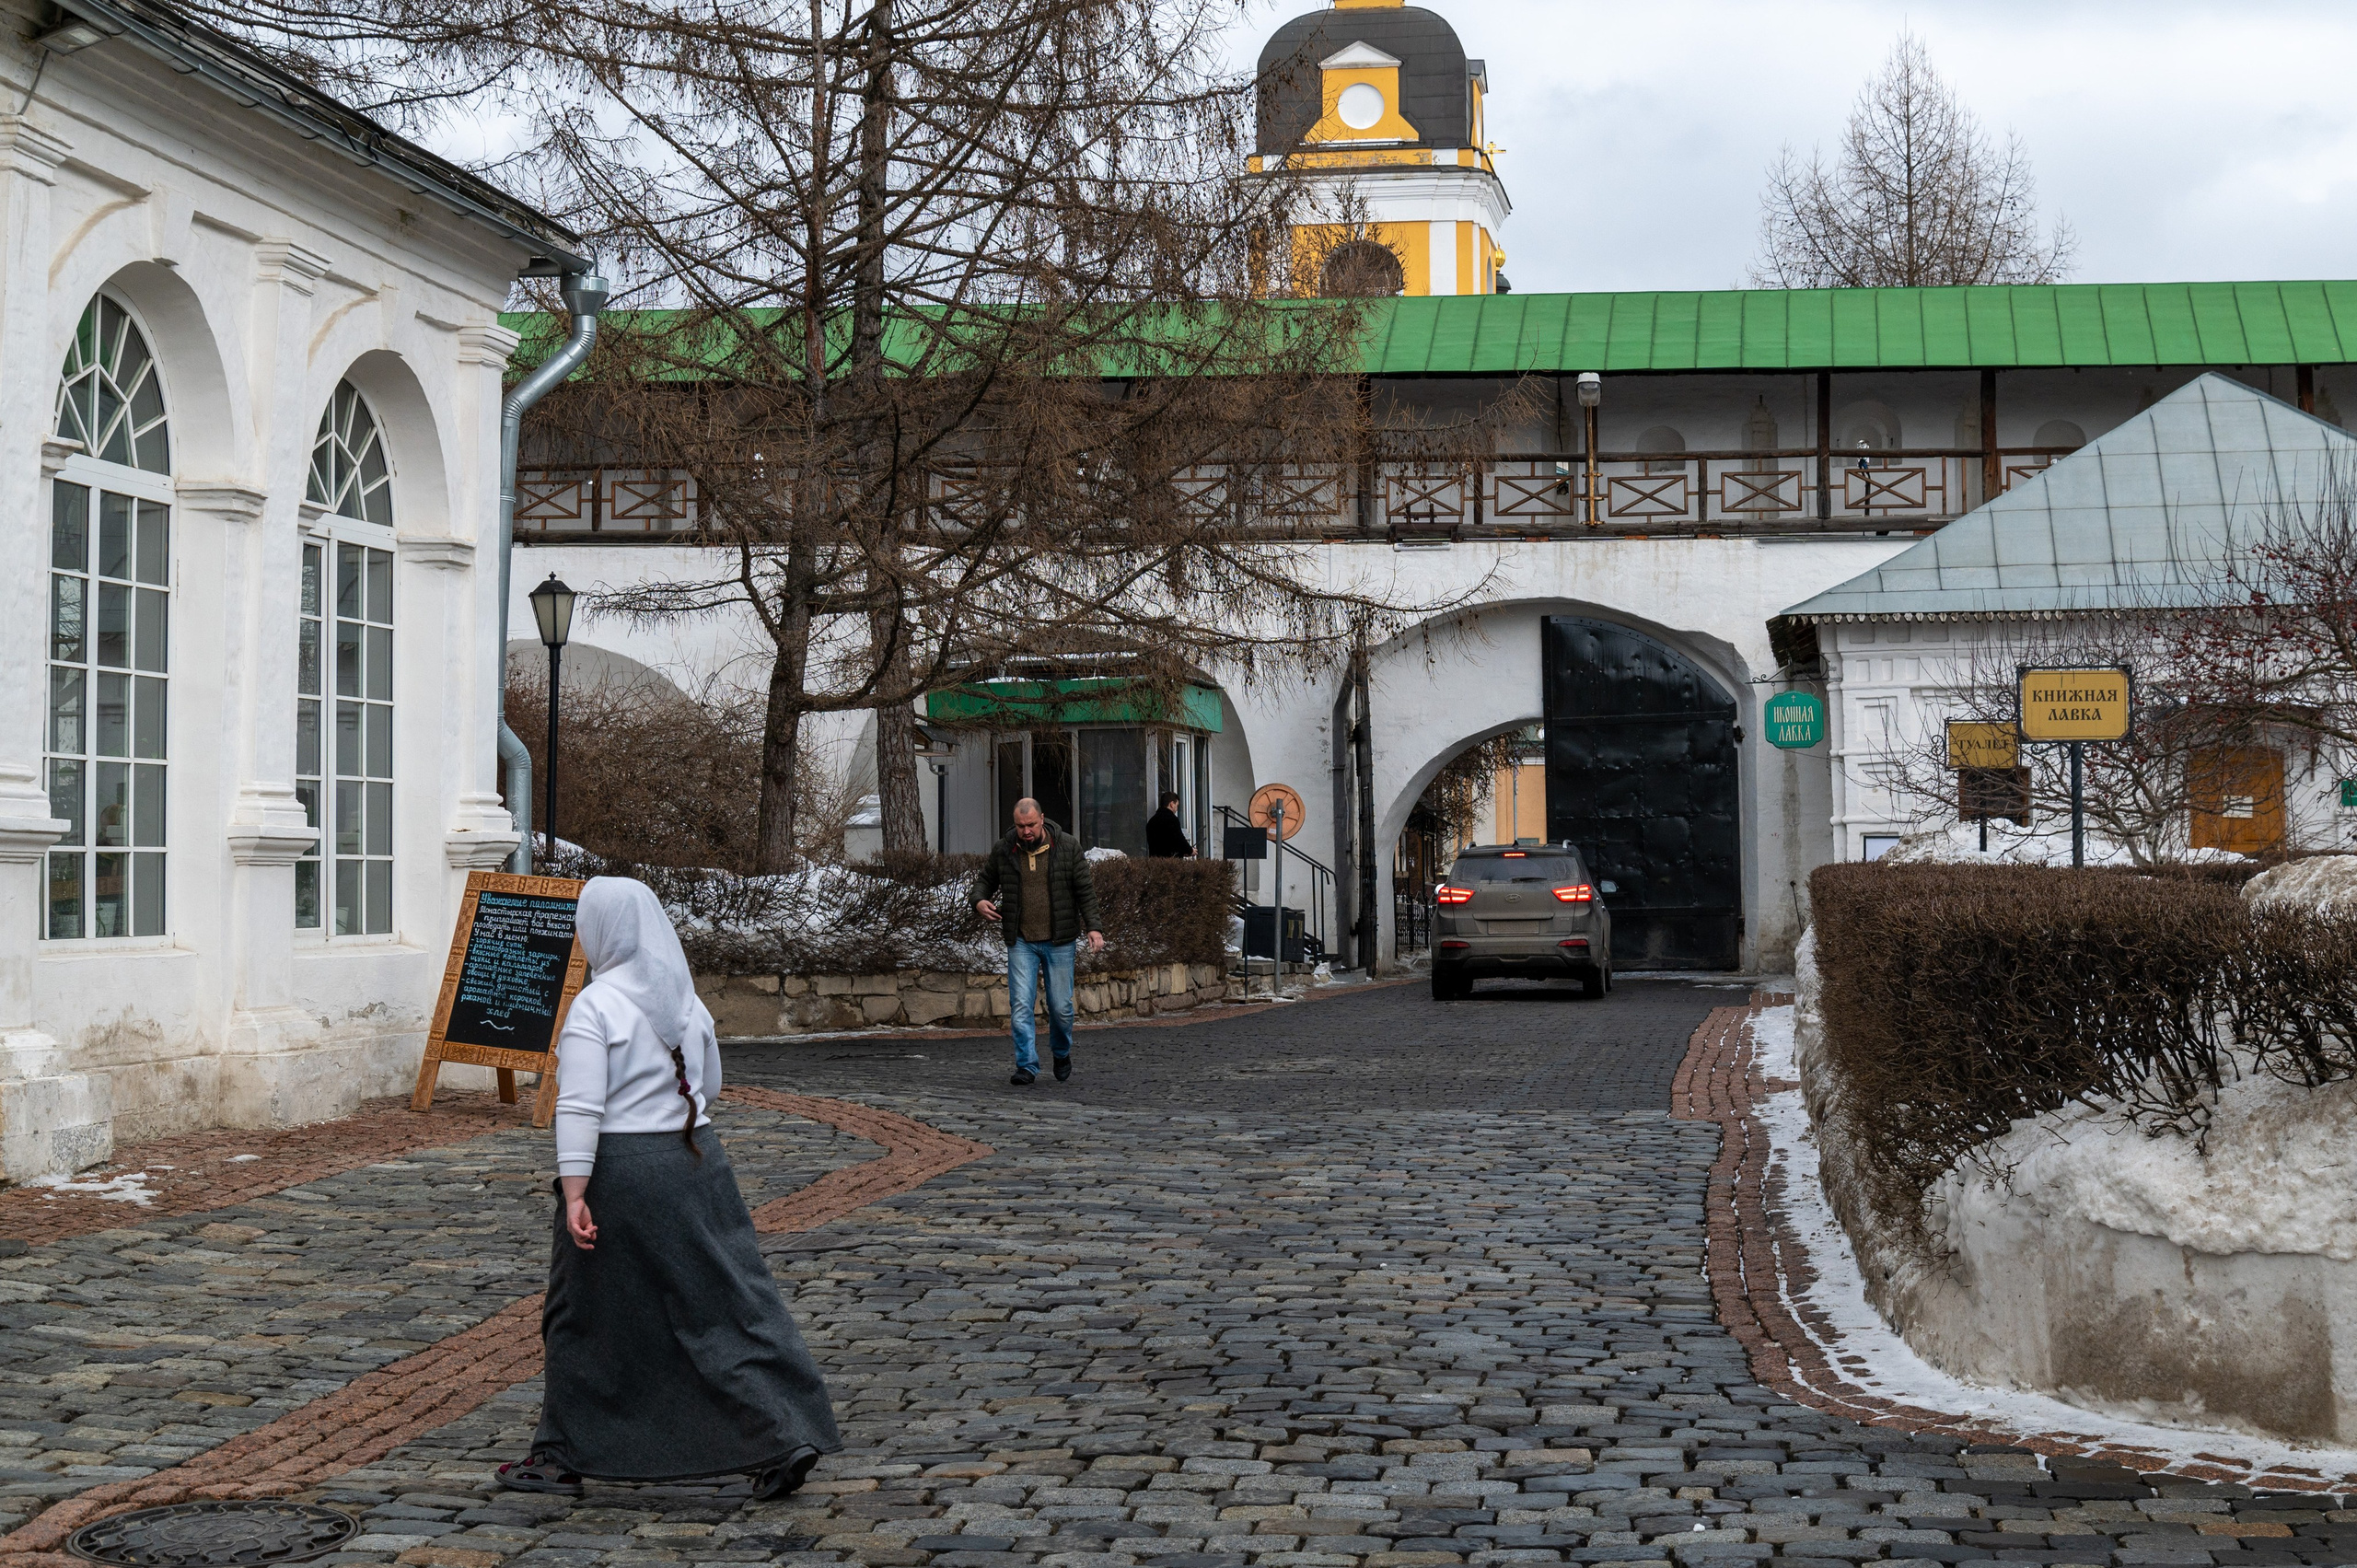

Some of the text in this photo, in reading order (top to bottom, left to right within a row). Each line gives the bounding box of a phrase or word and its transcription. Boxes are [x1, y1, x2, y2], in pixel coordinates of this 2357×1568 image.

[2032, 689, 2119, 703] КНИЖНАЯ
[1773, 705, 1814, 723] ИКОННАЯ
[2048, 708, 2103, 721] ЛАВКА
[1778, 725, 1811, 742] ЛАВКА
[1956, 738, 2009, 749] ТУАЛЕТ
[480, 892, 528, 907] Уважаемые
[479, 906, 532, 919] Монастырская
[484, 915, 571, 930] приглашает вас вкусно
[473, 922, 511, 933] пообедать
[529, 928, 575, 938] поужинать
[470, 955, 491, 964] щуки
[467, 969, 490, 979] овощи
[460, 994, 493, 1004] ржаной
[486, 1007, 513, 1018] хлеб
